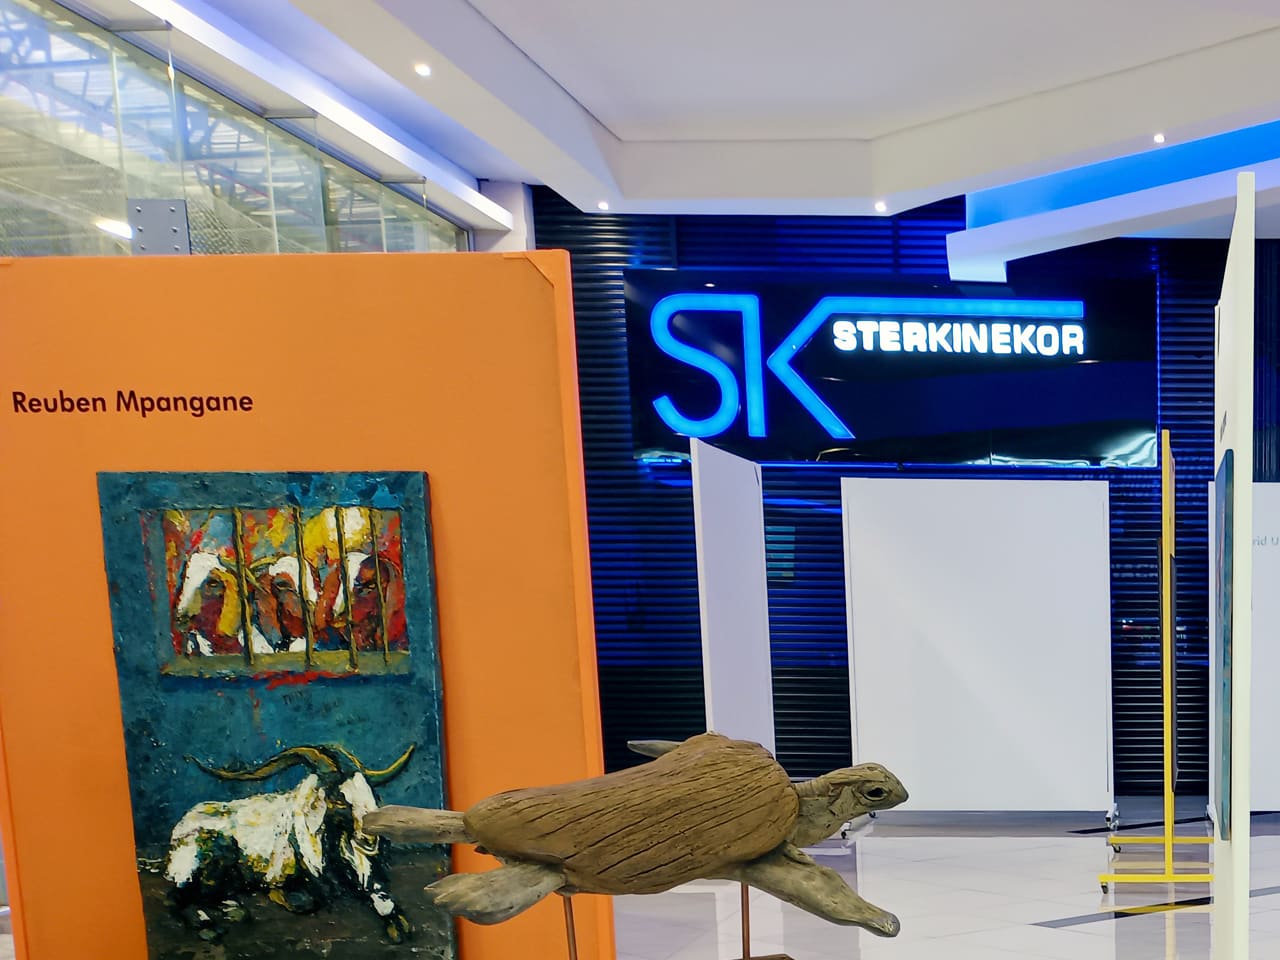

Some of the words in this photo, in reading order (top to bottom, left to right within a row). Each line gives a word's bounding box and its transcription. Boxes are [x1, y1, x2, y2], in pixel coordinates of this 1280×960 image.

[832, 320, 1085, 356] STERKINEKOR
[650, 293, 856, 439] SK
[12, 389, 107, 413] Reuben
[116, 390, 254, 418] Mpangane
[1252, 535, 1267, 547] rid
